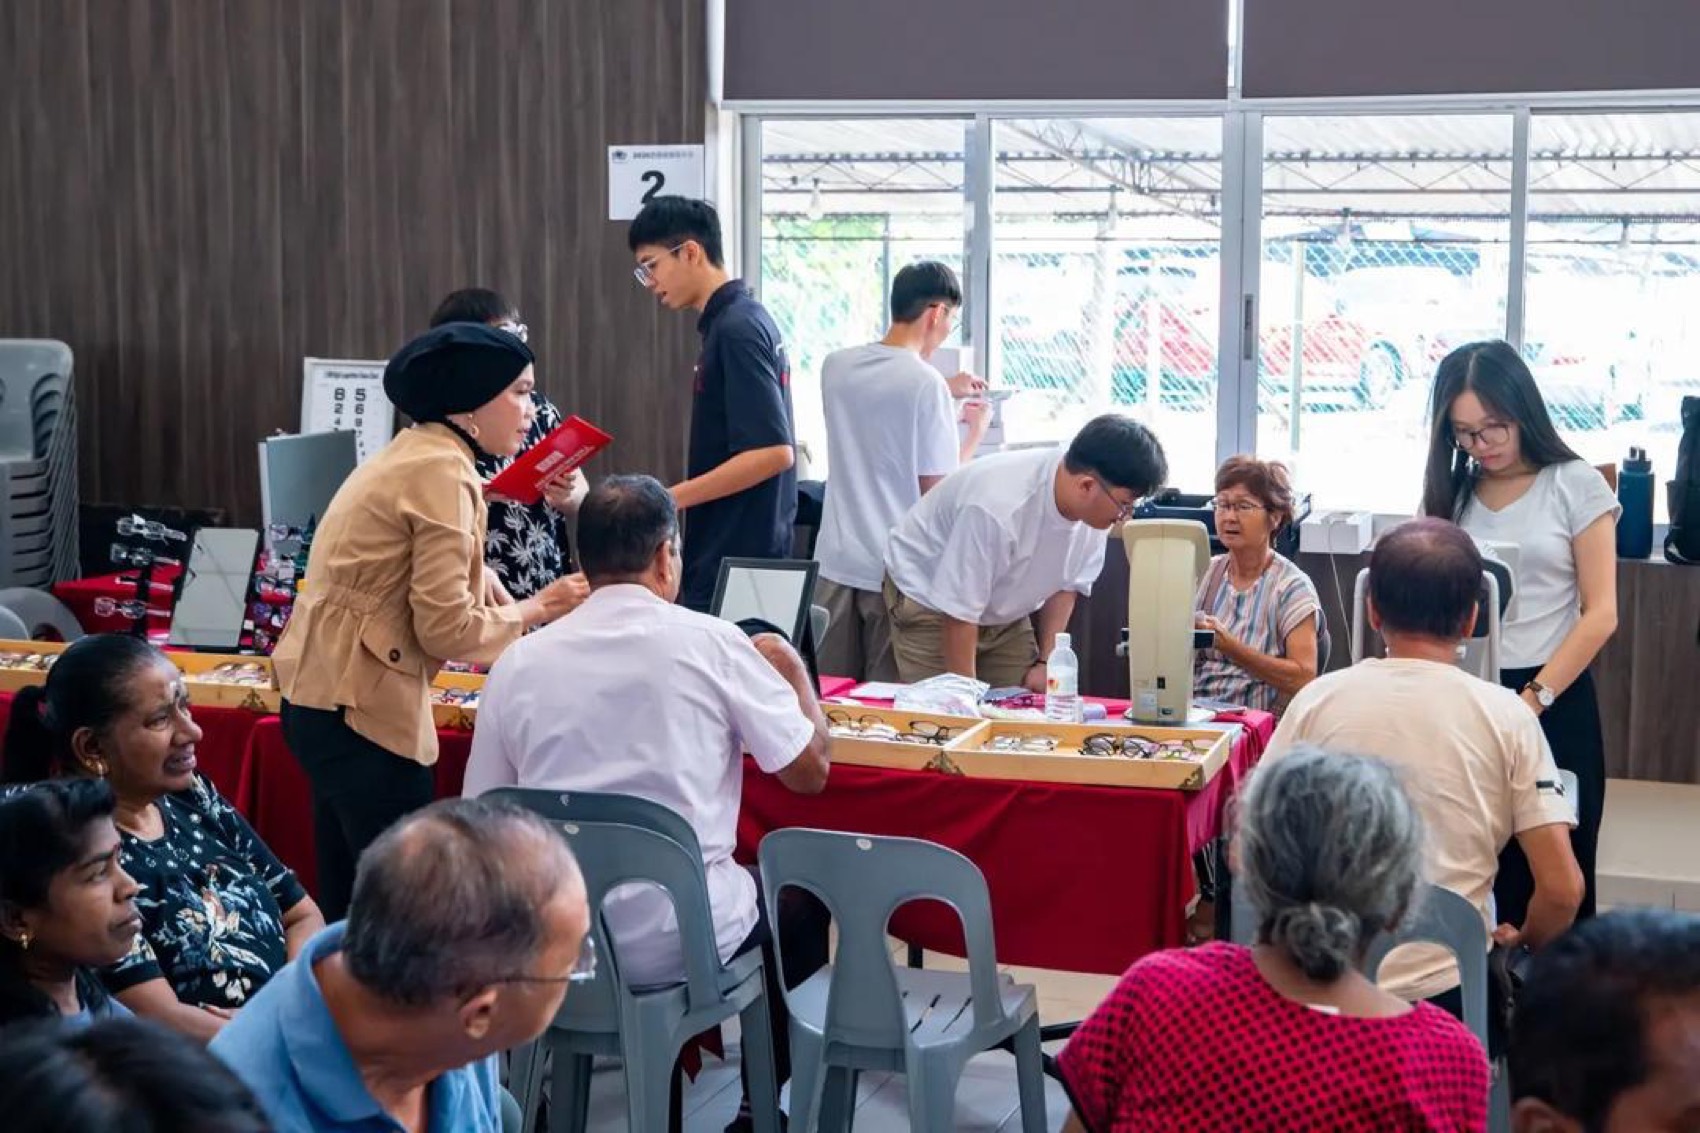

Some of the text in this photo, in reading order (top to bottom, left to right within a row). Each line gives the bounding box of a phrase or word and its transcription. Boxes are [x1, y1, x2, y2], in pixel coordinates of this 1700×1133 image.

[641, 170, 665, 204] 2
[355, 388, 366, 401] 5
[334, 403, 364, 415] 2 6
